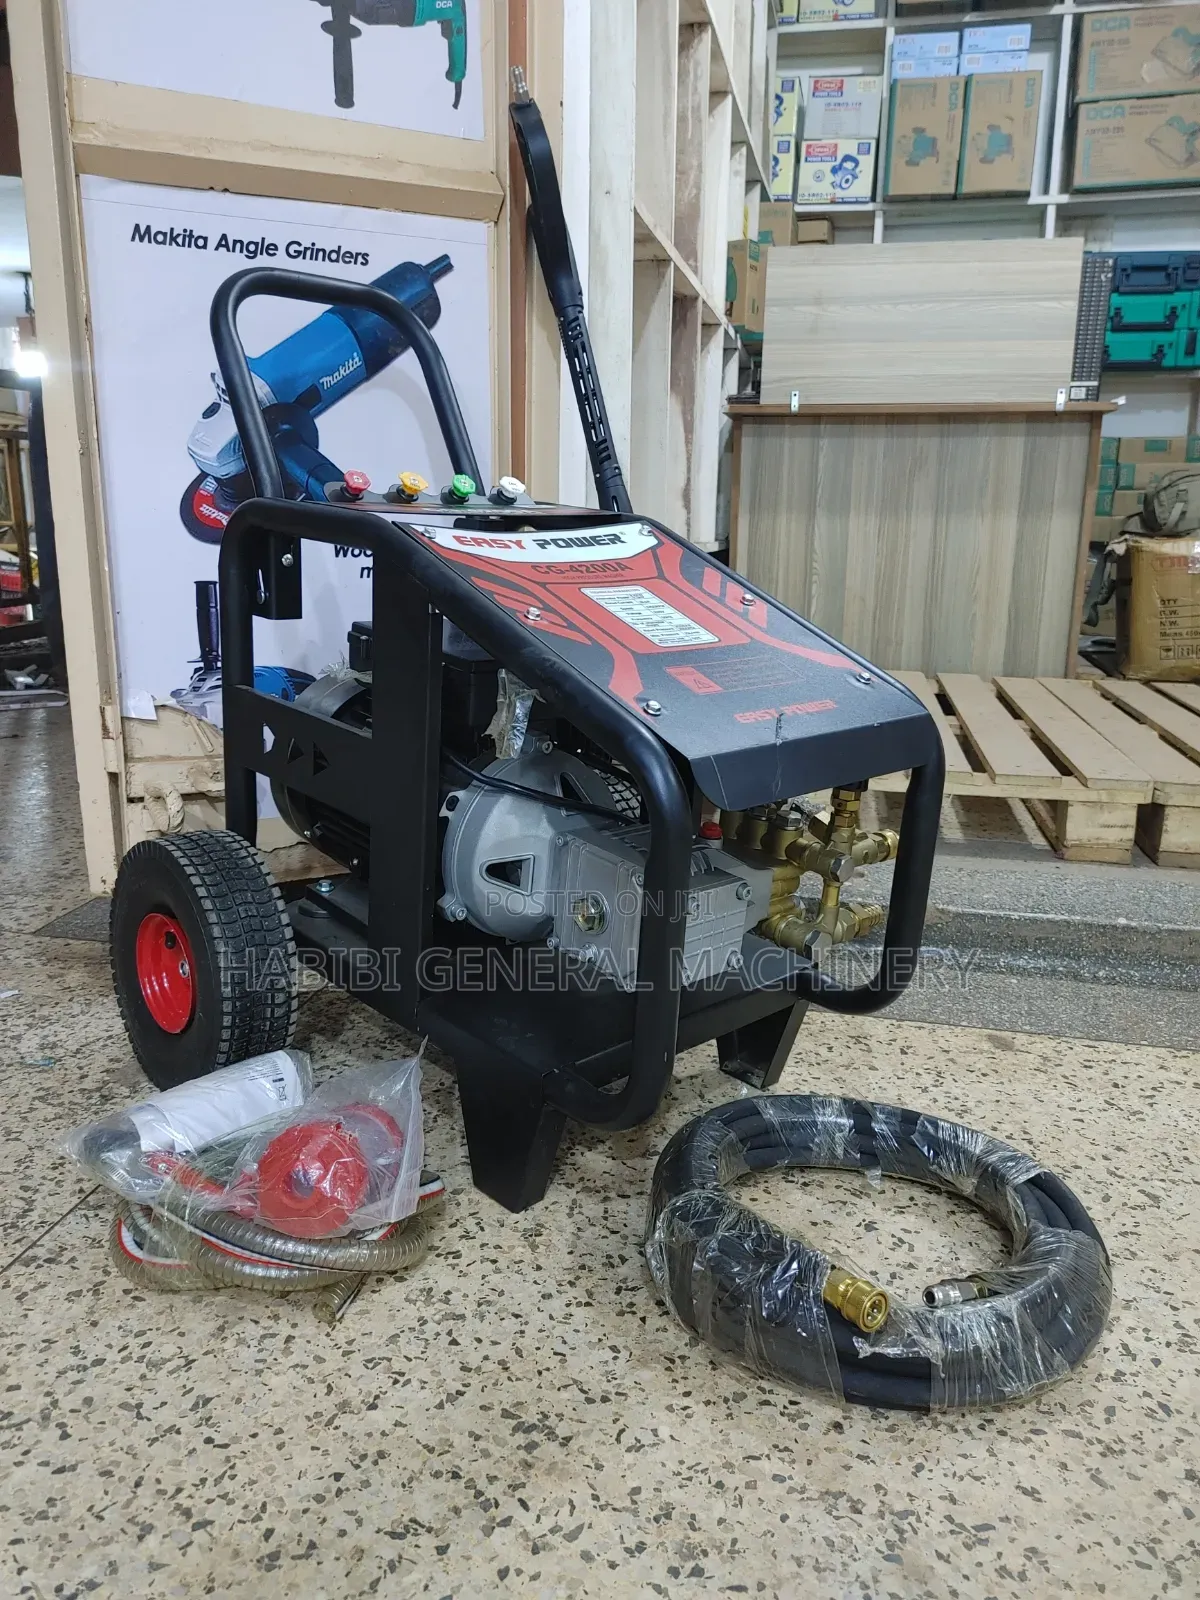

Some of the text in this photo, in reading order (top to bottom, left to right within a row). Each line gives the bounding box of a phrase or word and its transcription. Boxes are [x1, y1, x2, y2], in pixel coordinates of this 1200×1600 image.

[436, 1, 453, 9] DCA
[1091, 16, 1131, 32] DCA
[1086, 105, 1126, 120] DCA
[130, 223, 370, 266] Makita Angle Grinders
[452, 533, 628, 550] EASY POWER
[530, 562, 634, 576] CG-4200A
